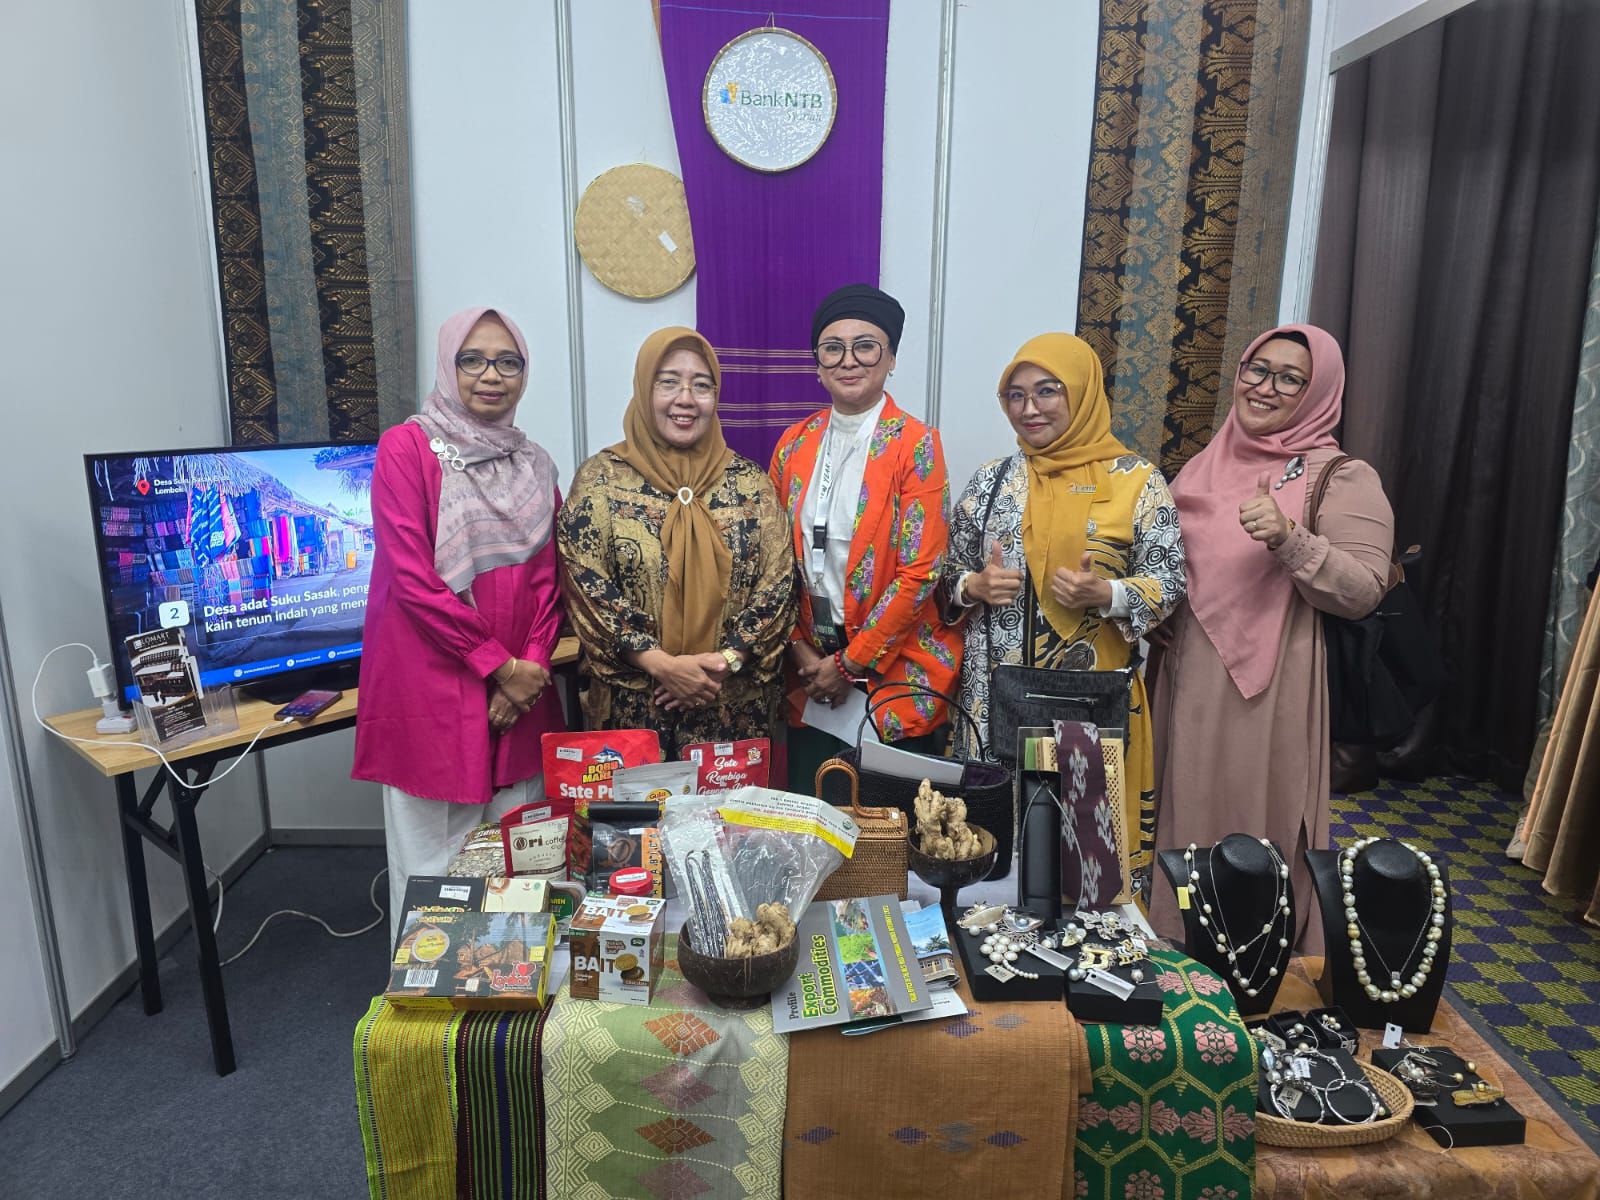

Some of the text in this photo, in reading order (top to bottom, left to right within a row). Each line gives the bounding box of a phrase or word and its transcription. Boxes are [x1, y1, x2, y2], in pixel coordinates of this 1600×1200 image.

[153, 479, 173, 487] Desa
[203, 604, 237, 617] Desa
[240, 598, 268, 612] adat
[271, 594, 301, 607] Suku
[304, 587, 340, 602] Sasak,
[169, 608, 180, 619] 2
[205, 619, 233, 633] kain
[236, 614, 273, 628] tenun
[275, 607, 308, 622] indah
[311, 604, 339, 618] yang
[714, 757, 739, 770] Sate
[560, 783, 593, 799] Sate
[584, 906, 625, 919] BAIT
[574, 955, 616, 974] BAIT
[815, 934, 838, 1016] Commodities
[802, 972, 821, 1018] Export
[788, 992, 799, 1020] Profile
